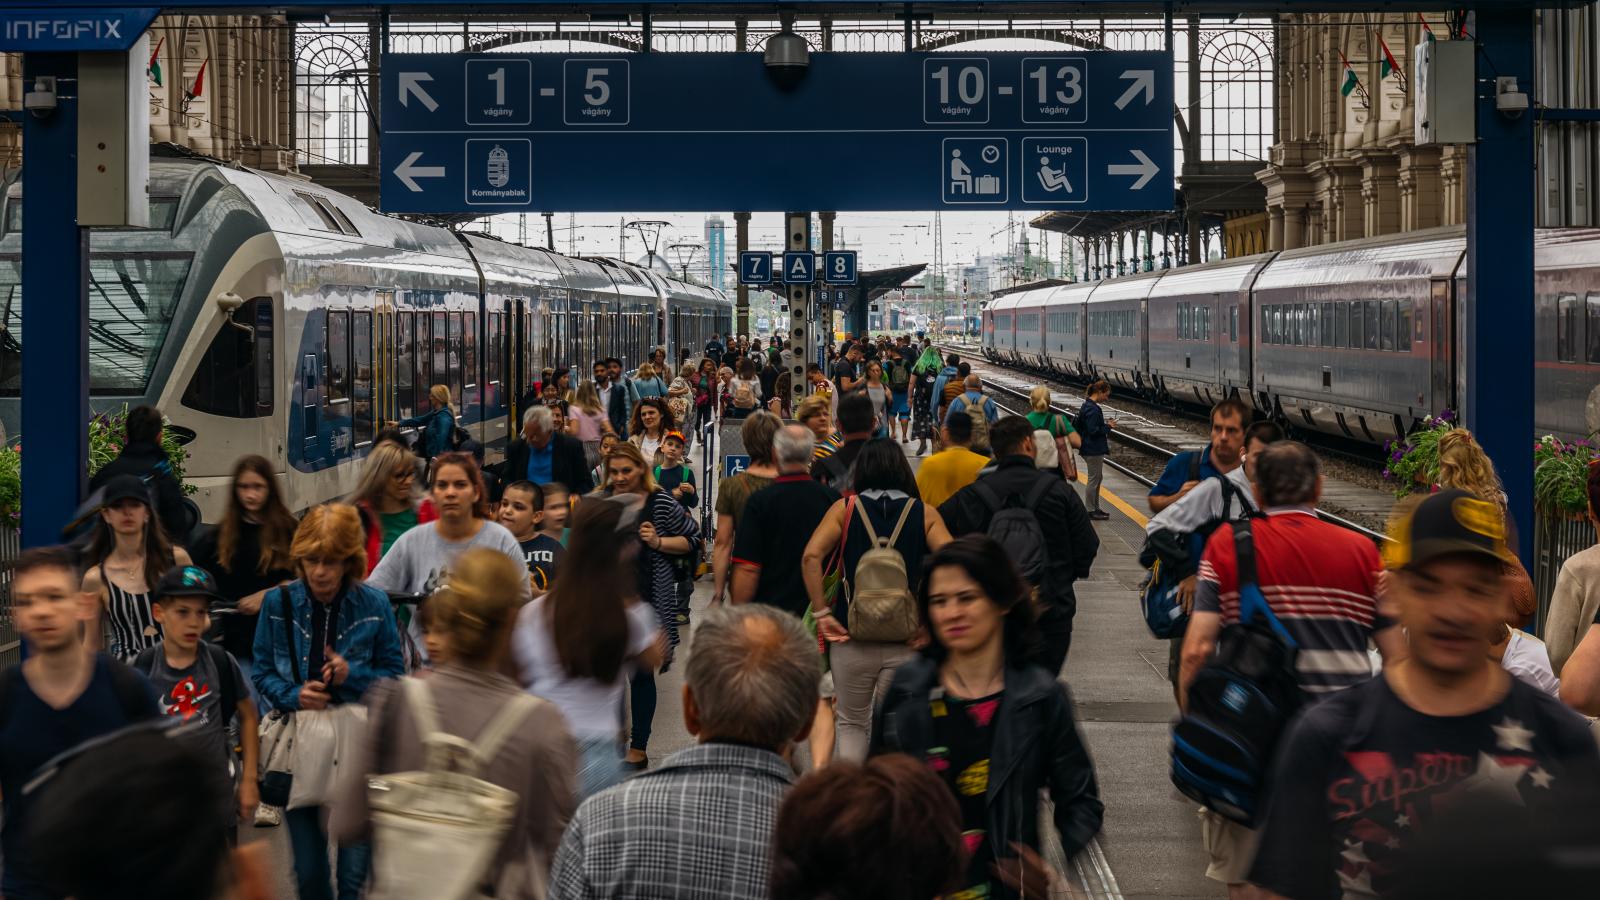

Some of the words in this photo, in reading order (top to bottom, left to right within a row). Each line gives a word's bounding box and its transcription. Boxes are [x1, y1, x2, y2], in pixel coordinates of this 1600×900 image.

[6, 20, 121, 39] INFOPIX
[488, 68, 505, 105] 1
[584, 68, 610, 106] 5
[931, 66, 985, 105] 10
[1029, 66, 1082, 105] 13
[483, 107, 513, 117] vágány
[581, 107, 611, 117] vágány
[941, 105, 971, 115] vágány
[1039, 105, 1069, 115] vágány
[1036, 145, 1073, 155] Lounge
[471, 189, 526, 198] Kormányablak
[750, 257, 762, 274] 7
[791, 257, 807, 274] A
[834, 256, 846, 274] 8
[838, 291, 844, 299] 8
